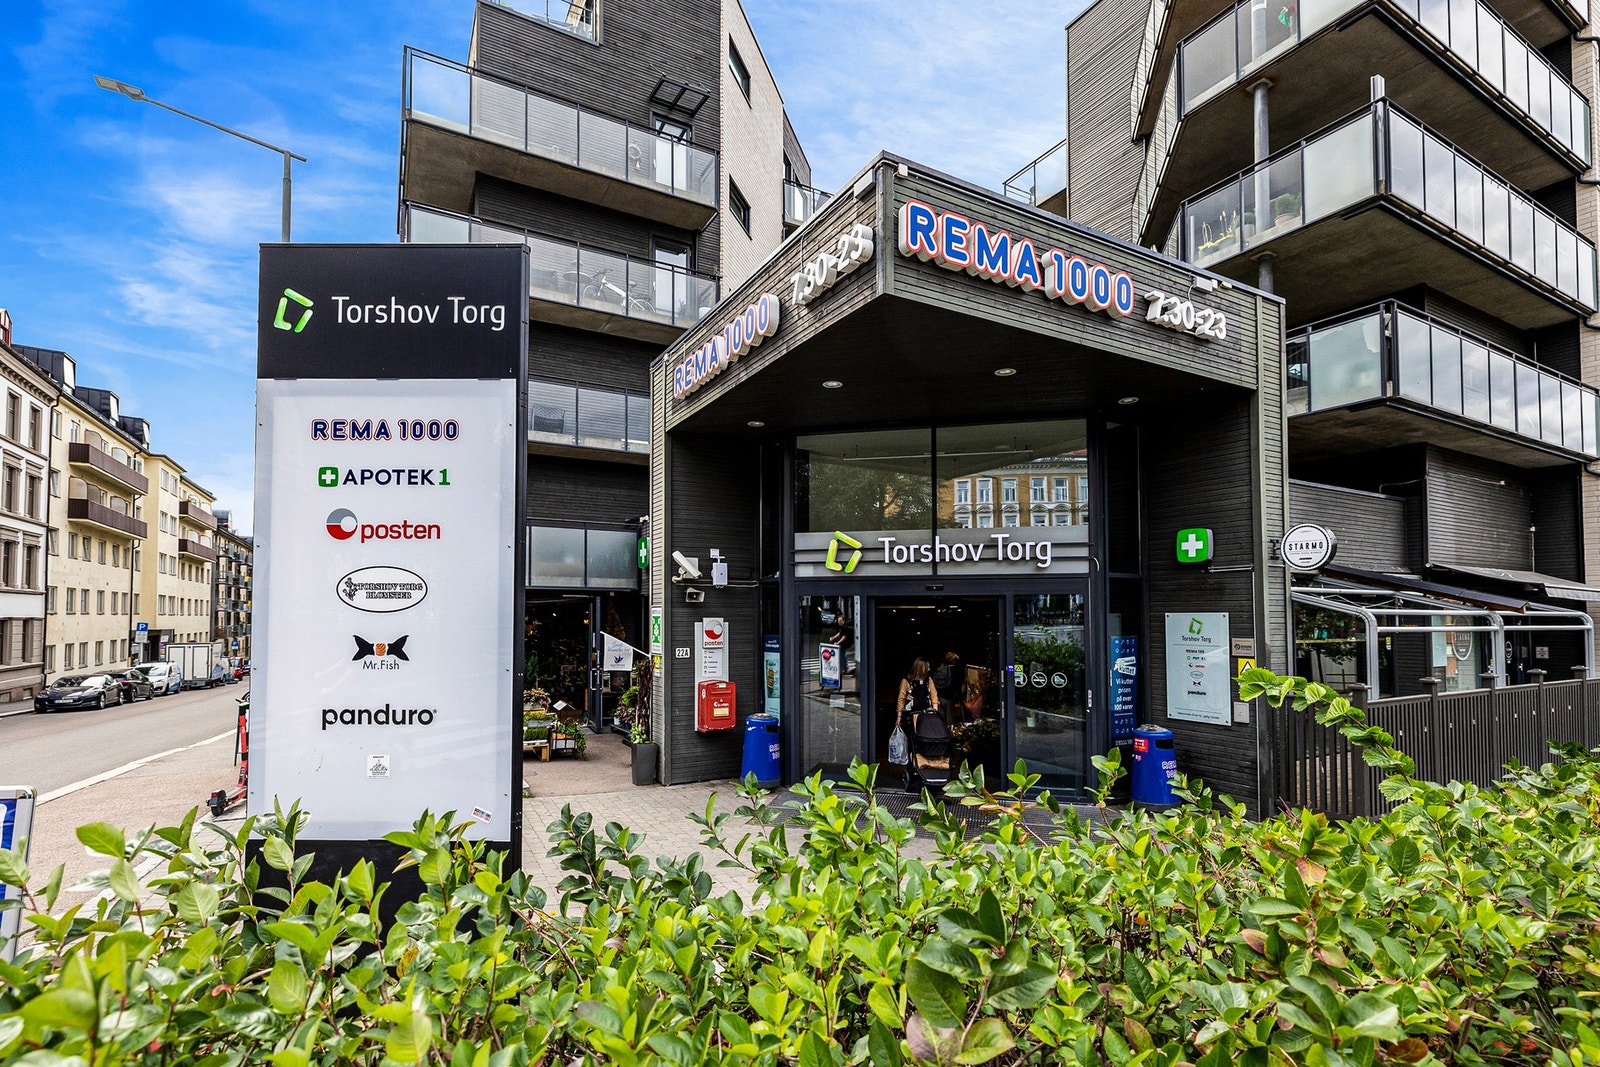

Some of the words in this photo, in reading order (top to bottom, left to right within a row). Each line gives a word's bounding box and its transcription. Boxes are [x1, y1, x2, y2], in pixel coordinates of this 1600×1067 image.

[791, 223, 874, 306] 7.30-23
[904, 200, 1041, 288] REMA
[1047, 247, 1135, 317] 1000
[331, 296, 440, 324] Torshov
[447, 296, 506, 331] Torg
[1145, 290, 1227, 341] 7.30-23
[673, 335, 722, 399] REMA
[724, 293, 773, 360] 1000
[311, 419, 392, 441] REMA
[398, 419, 460, 441] 1000
[343, 469, 435, 485] APOTEK
[438, 469, 450, 485] 1
[361, 520, 441, 543] posten
[878, 535, 984, 564] Torshov
[990, 533, 1053, 568] Torg
[1288, 541, 1324, 551] STARMO
[357, 583, 398, 592] TORSHOV
[399, 582, 424, 591] TORG
[365, 591, 412, 599] BLOMSTER
[676, 649, 689, 657] 22A
[362, 660, 400, 670] Mr.Fish
[322, 704, 437, 730] panduro
